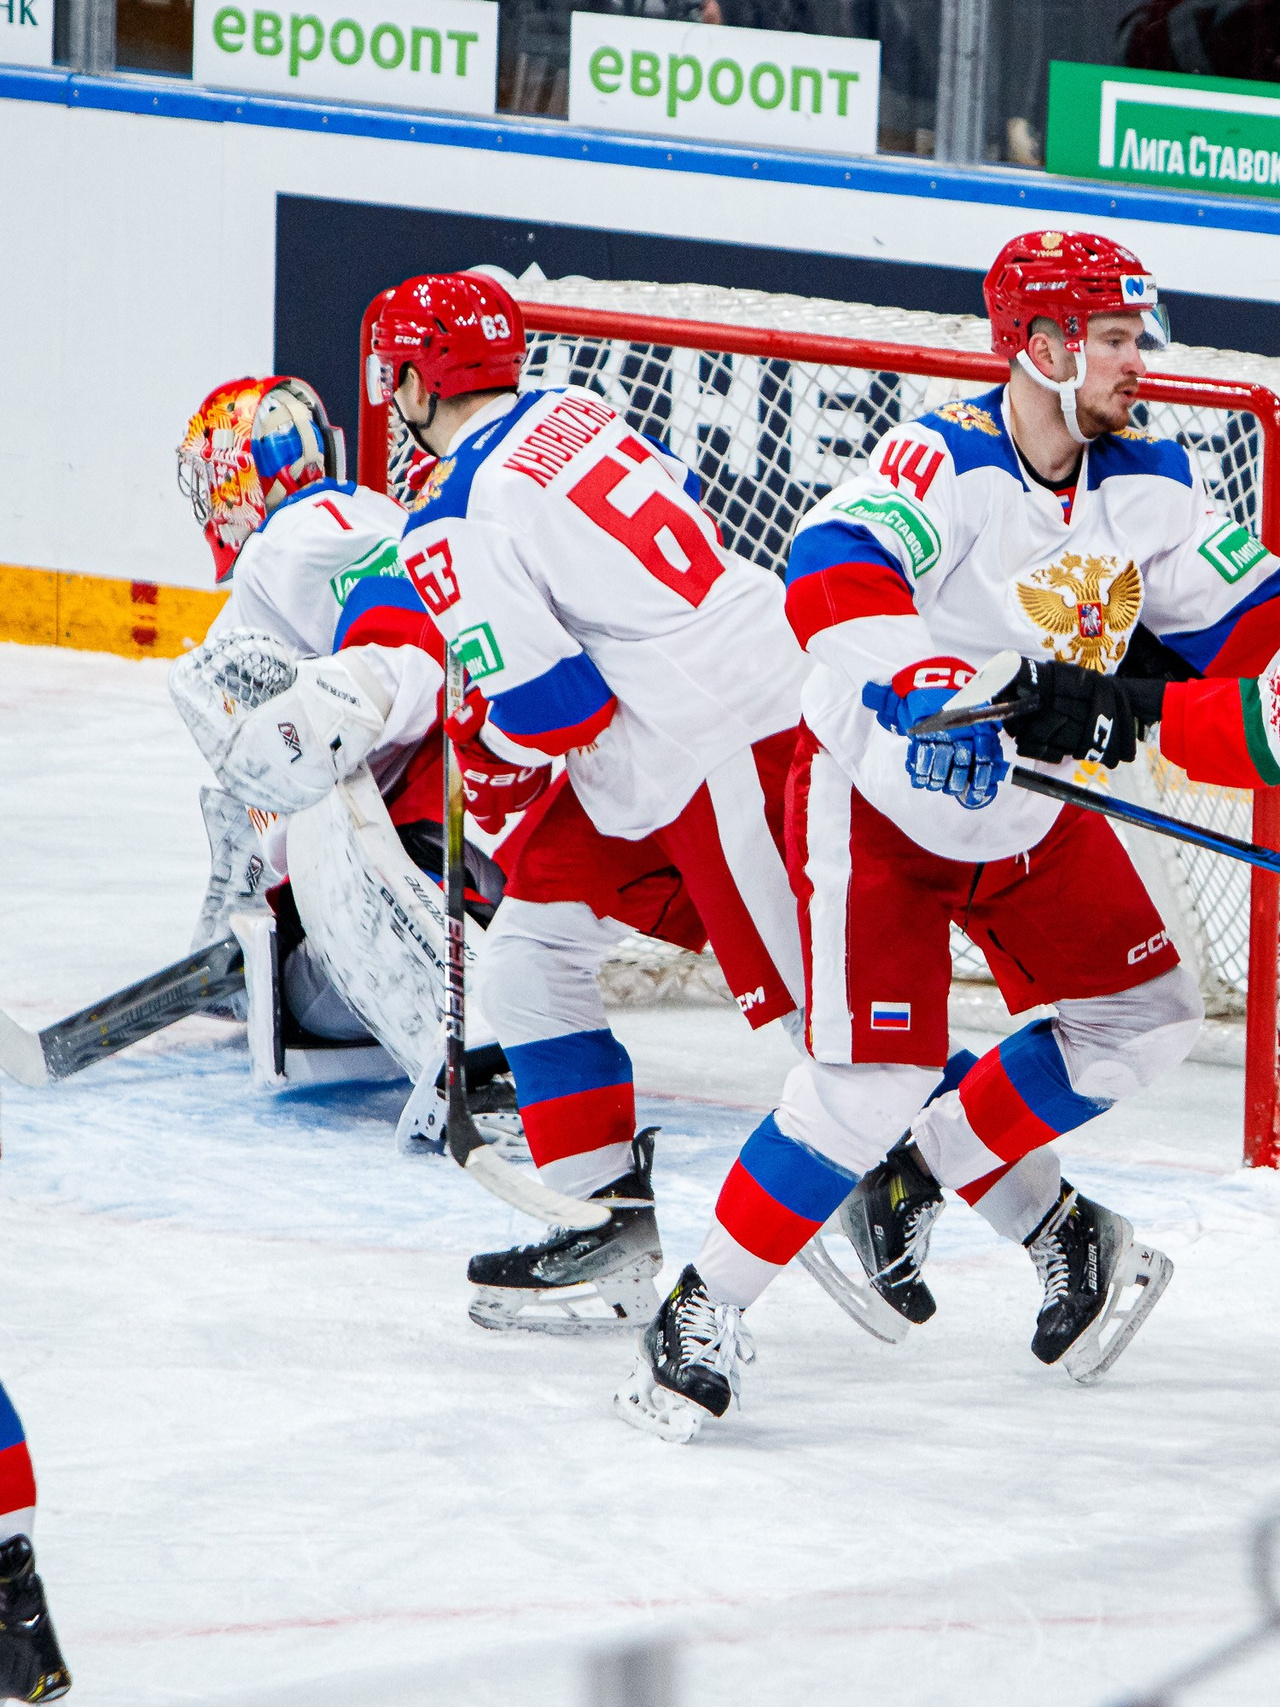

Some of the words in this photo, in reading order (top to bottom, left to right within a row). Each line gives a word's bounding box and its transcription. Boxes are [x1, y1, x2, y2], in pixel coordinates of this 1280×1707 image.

[211, 7, 479, 77] евроопт
[589, 46, 860, 118] евроопт
[394, 334, 422, 346] CCM
[480, 313, 511, 341] 63
[878, 438, 946, 503] 44
[311, 497, 355, 532] 1
[404, 537, 462, 617] 63
